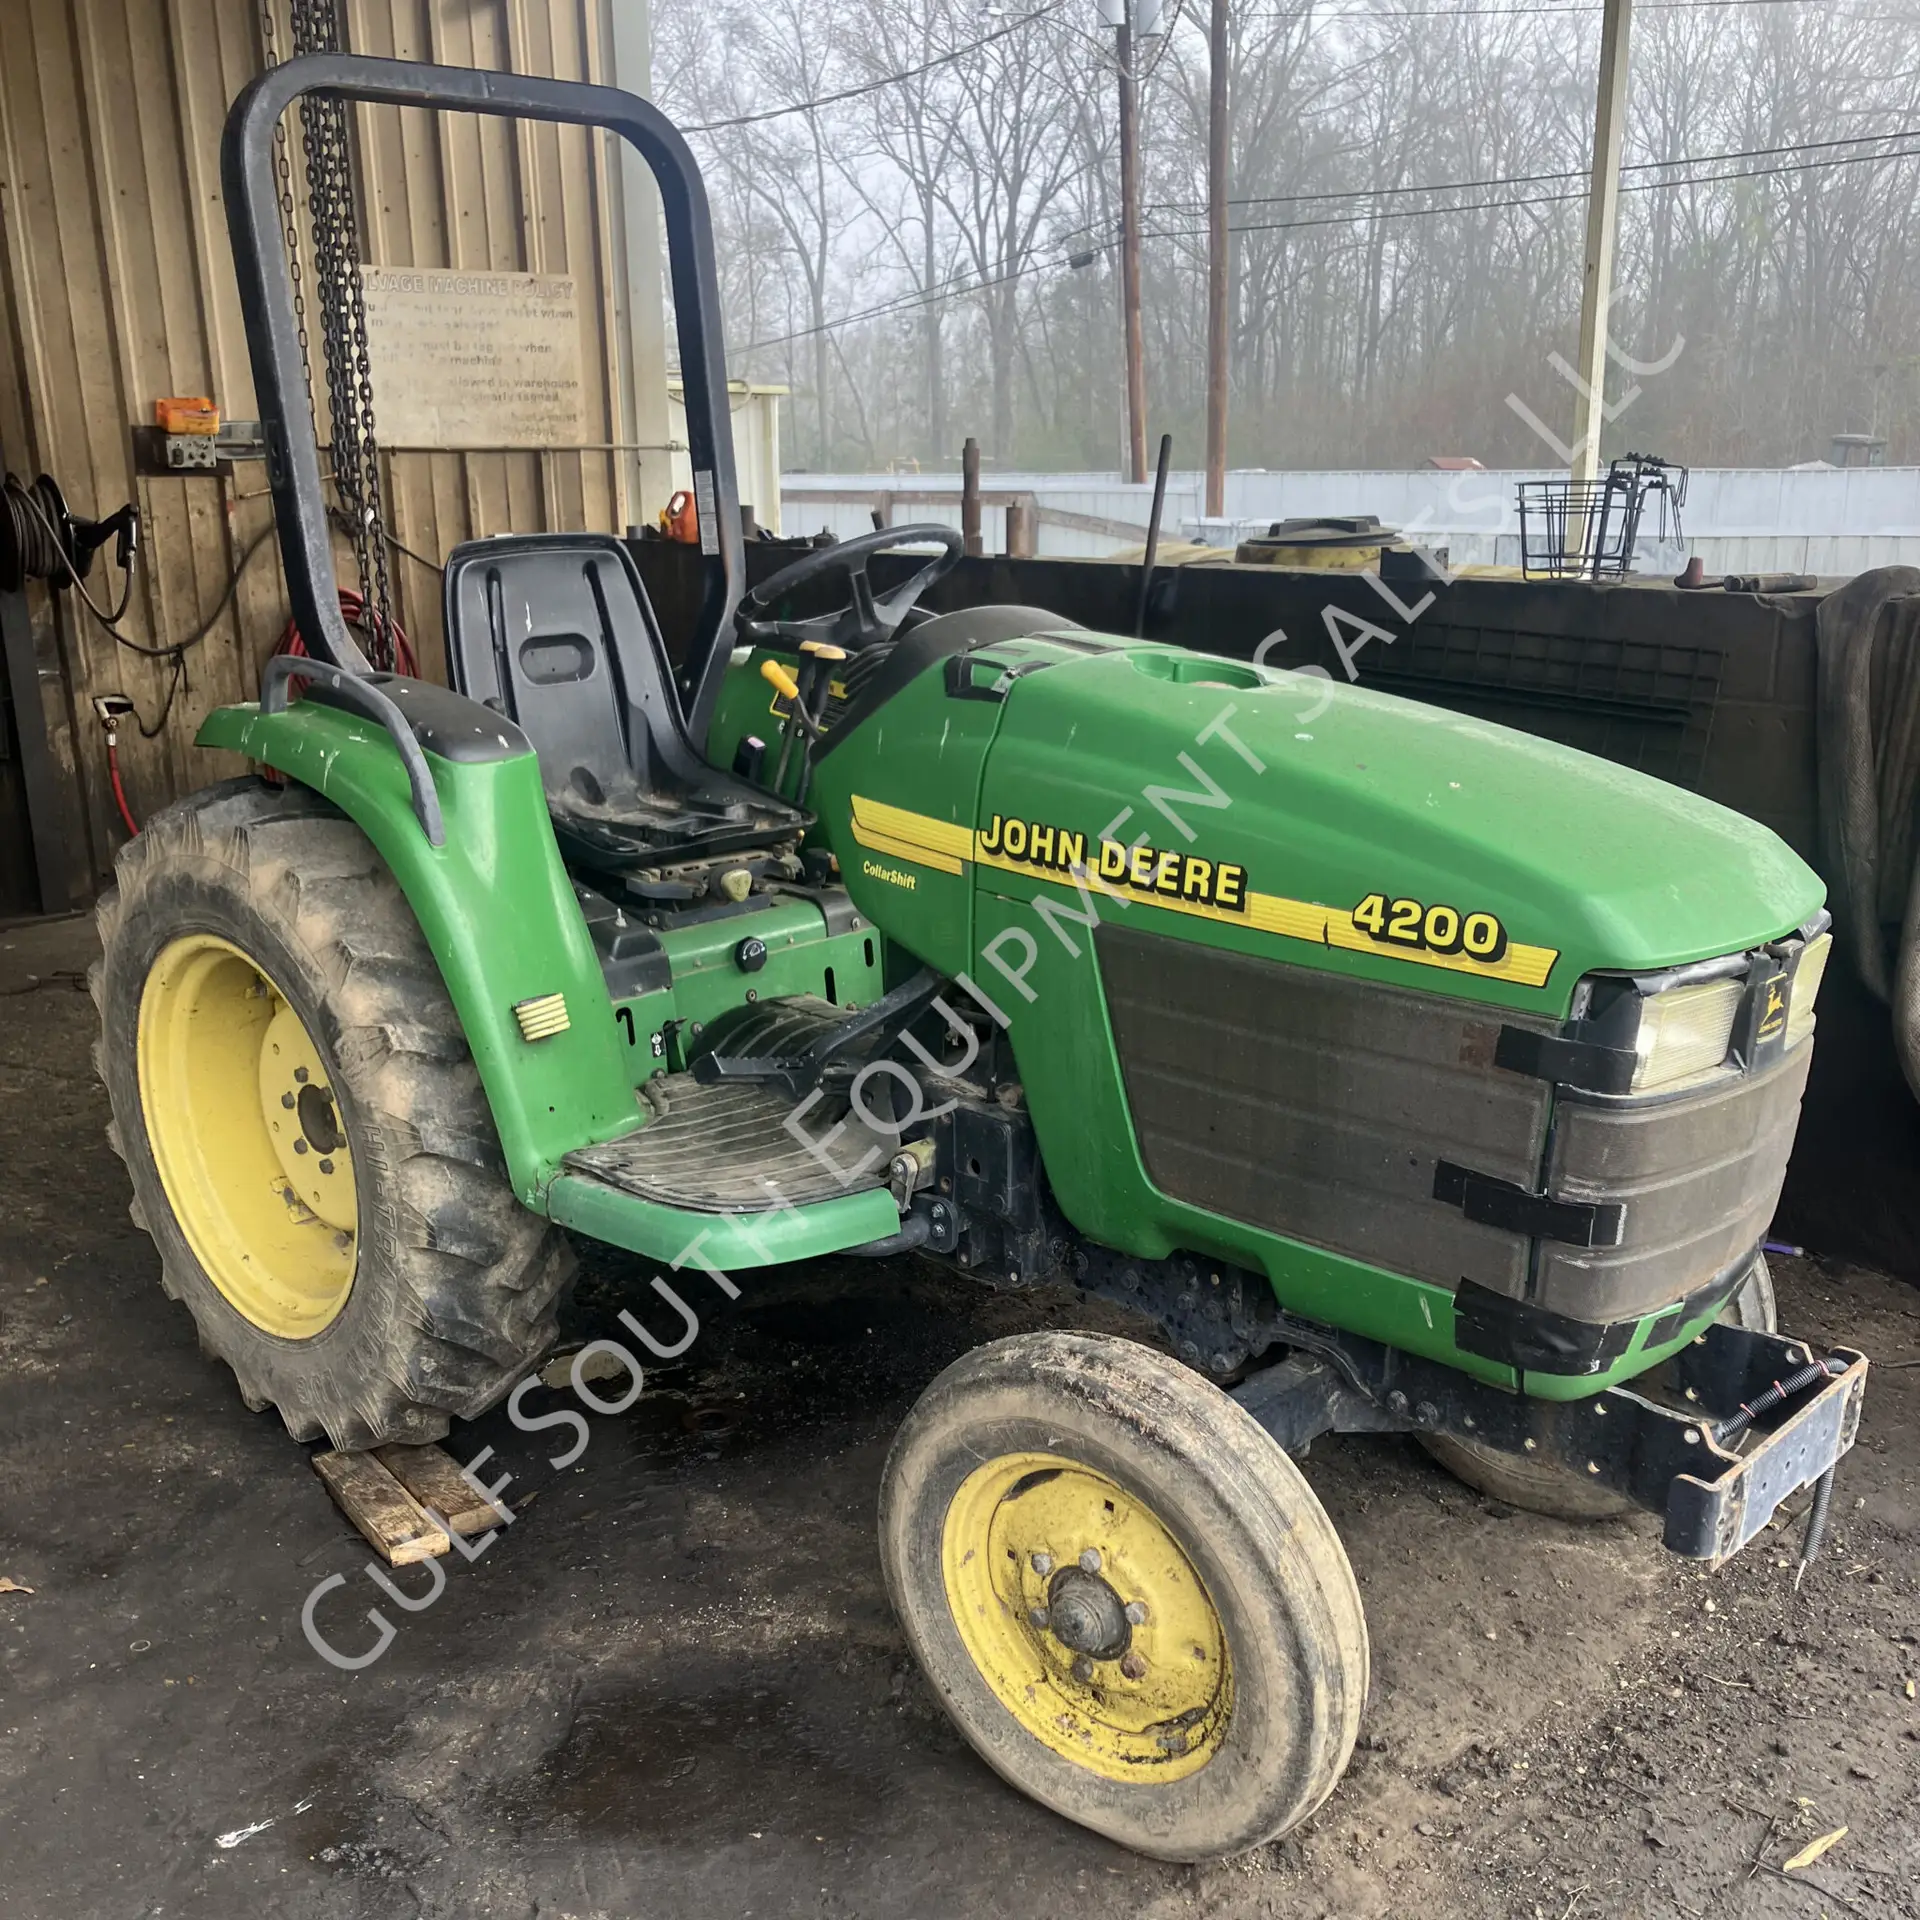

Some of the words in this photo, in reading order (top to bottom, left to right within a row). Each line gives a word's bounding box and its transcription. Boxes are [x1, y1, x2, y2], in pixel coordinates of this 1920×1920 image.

[363, 273, 424, 293] LVAGE
[428, 275, 509, 297] MACHINE
[513, 279, 575, 301] POLICY
[863, 860, 916, 890] CollarShift
[979, 813, 1088, 874] JOHN
[1100, 839, 1248, 913] DEERE
[1351, 892, 1508, 963] 4200
